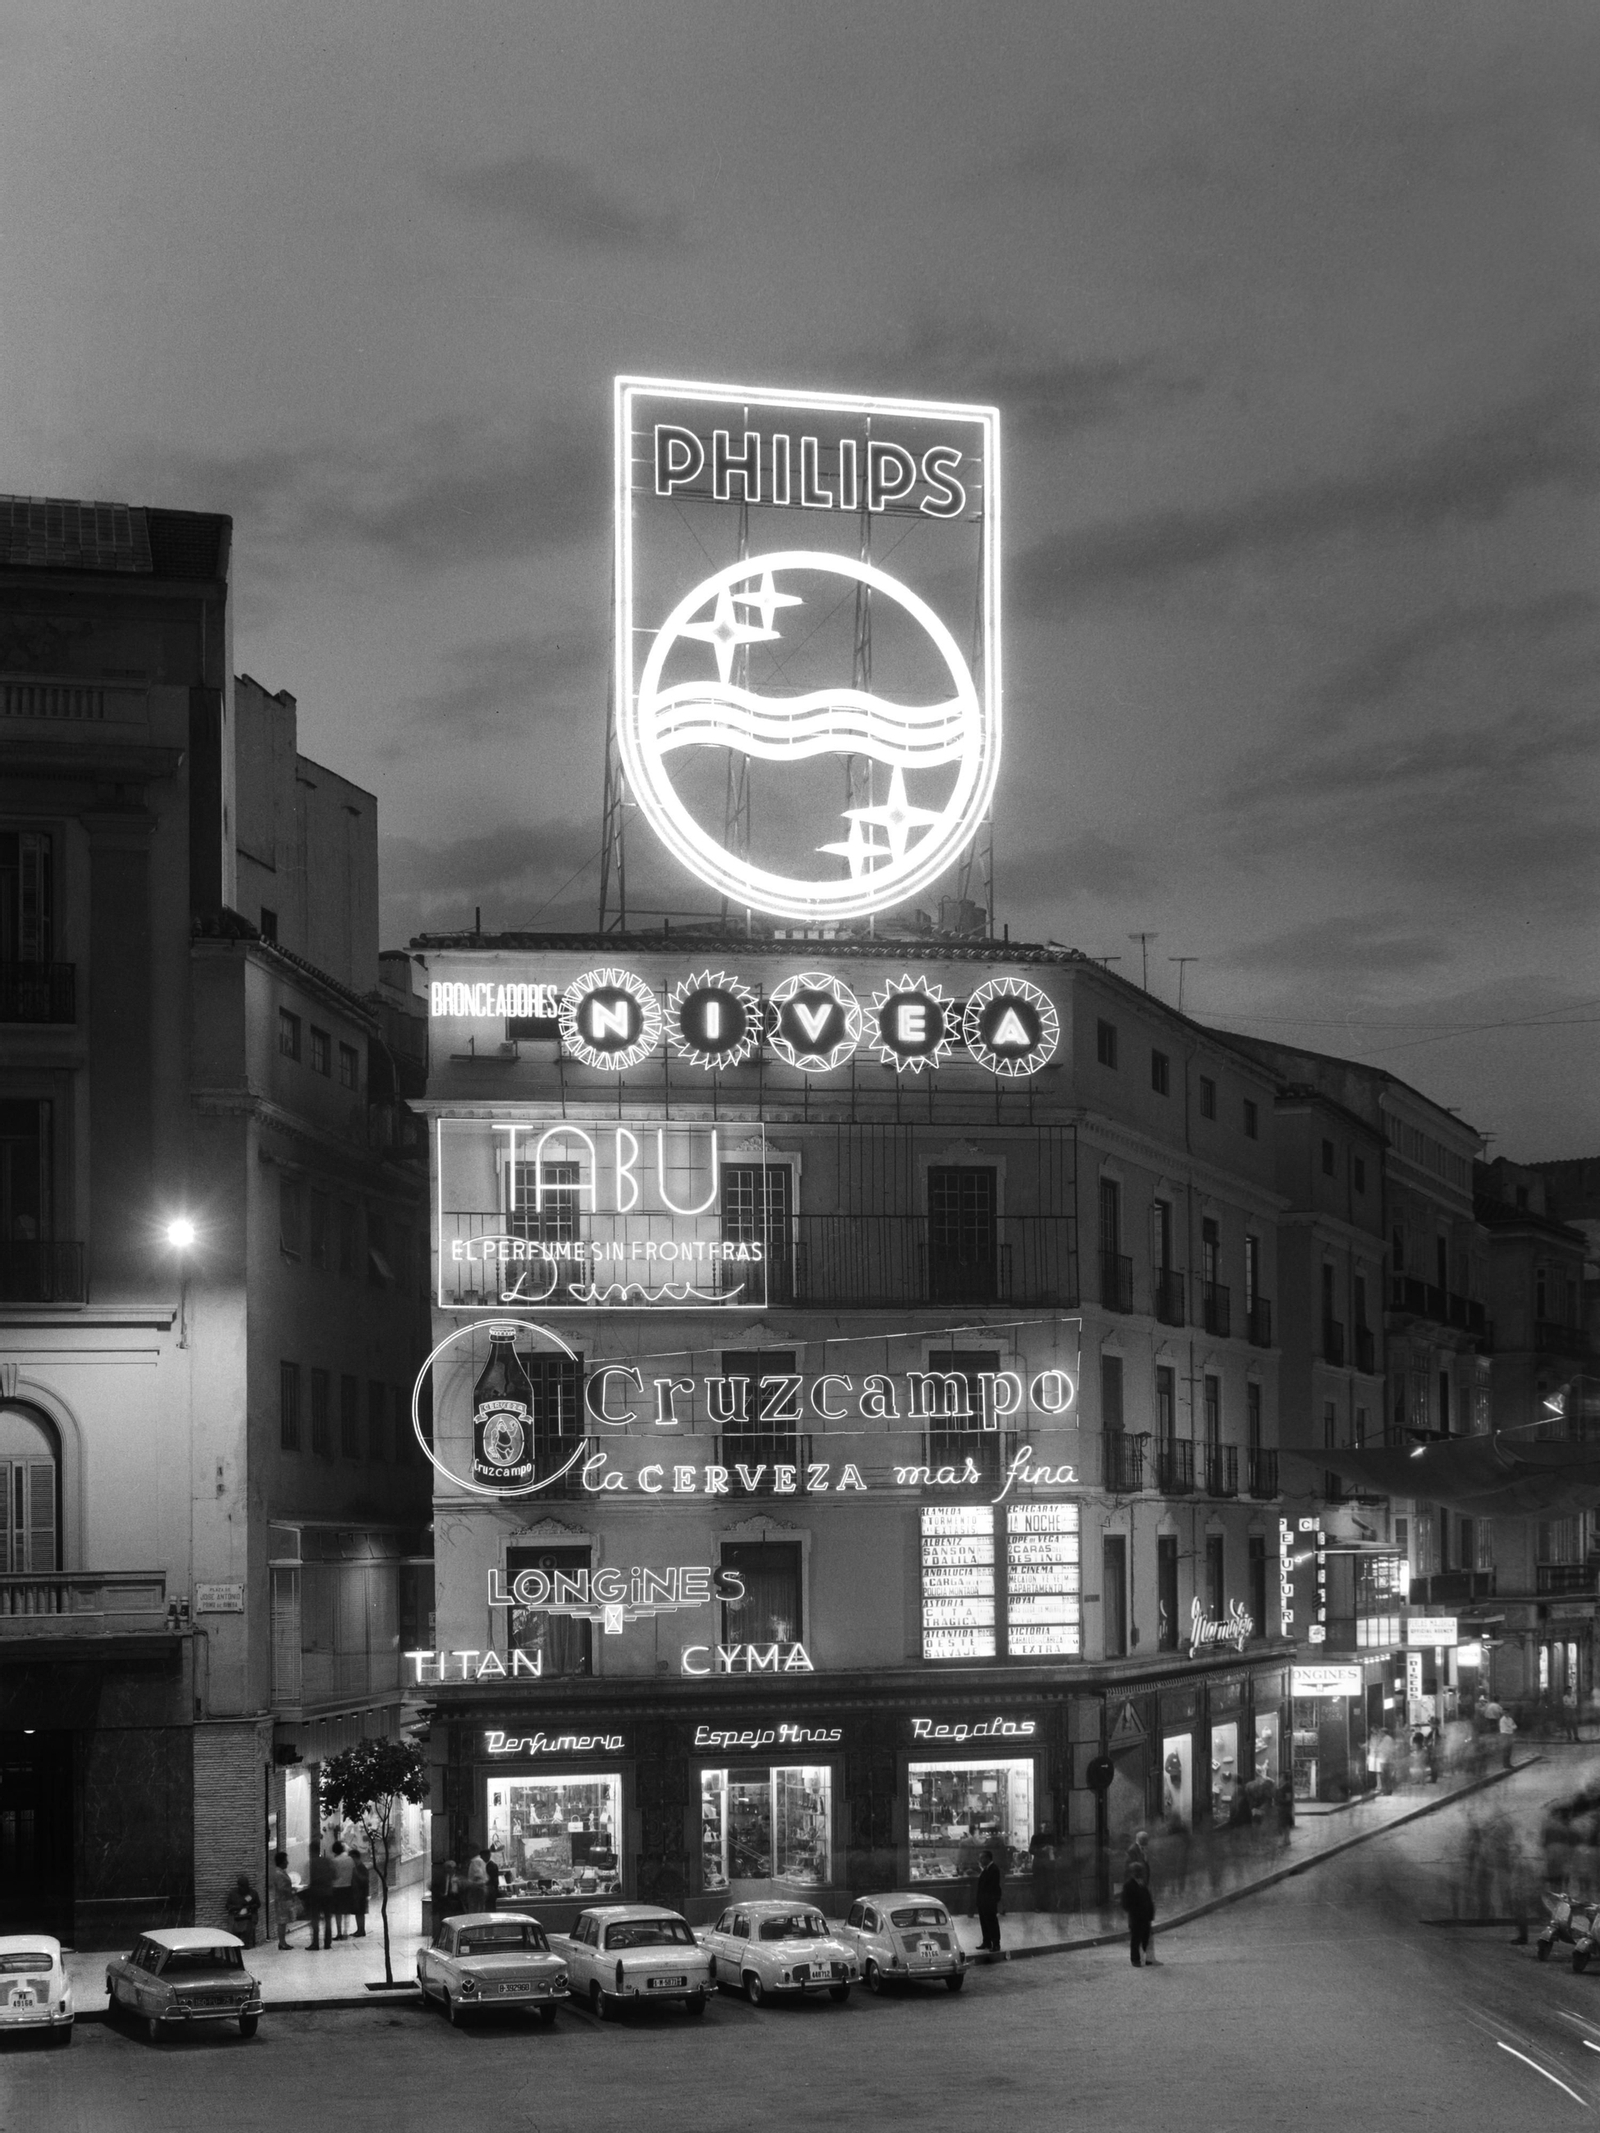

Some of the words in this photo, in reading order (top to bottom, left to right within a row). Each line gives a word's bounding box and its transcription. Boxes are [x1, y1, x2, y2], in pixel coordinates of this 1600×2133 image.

[655, 424, 966, 518] PHILIPS
[431, 981, 558, 1018] BRONCEADORES
[591, 998, 1031, 1046] NIVEA
[491, 1123, 718, 1215] TABU
[452, 1240, 477, 1261] EL
[483, 1241, 585, 1262] PERFUME
[591, 1241, 624, 1262] SIN
[585, 1364, 1074, 1431] Cruzcampo
[483, 1402, 523, 1411] CERVEZA
[475, 1458, 532, 1477] Cruzcampo
[583, 1453, 628, 1491] la
[638, 1464, 868, 1493] CERVEZA
[893, 1457, 981, 1485] mas
[991, 1445, 1079, 1502] fina
[921, 1508, 961, 1516] ALAMEDA
[929, 1516, 976, 1525] TORMENTO
[1025, 1514, 1060, 1531] NOCHE
[934, 1526, 976, 1535] EXTASIS
[923, 1538, 962, 1546] ALBENIZ
[1038, 1535, 1059, 1543] VEGA
[923, 1547, 975, 1556] SANSON
[932, 1555, 977, 1565] DALILA
[924, 1568, 973, 1576] ANDALUCIA
[1021, 1566, 1053, 1574] CINEMA
[929, 1578, 964, 1587] CARGA
[924, 1599, 963, 1607] ASTORIA
[1009, 1596, 1036, 1604] ROYAL
[926, 1608, 972, 1616] CITA
[925, 1617, 977, 1626] TRAGICA
[924, 1629, 973, 1638] ATLANTIDA
[1010, 1627, 1050, 1635] VICTORIA
[926, 1639, 975, 1647] OESTE
[925, 1648, 977, 1657] SALVAJE
[1023, 1645, 1060, 1653] EXTRA
[682, 1643, 815, 1675] CYMA
[404, 1649, 541, 1683] TITAN
[1293, 1669, 1358, 1680] ONGINES
[1409, 1660, 1419, 1699] DISCOS
[912, 1717, 1036, 1742] Regalos
[694, 1726, 775, 1748] Espejo
[485, 1731, 625, 1755] Perfumeria
